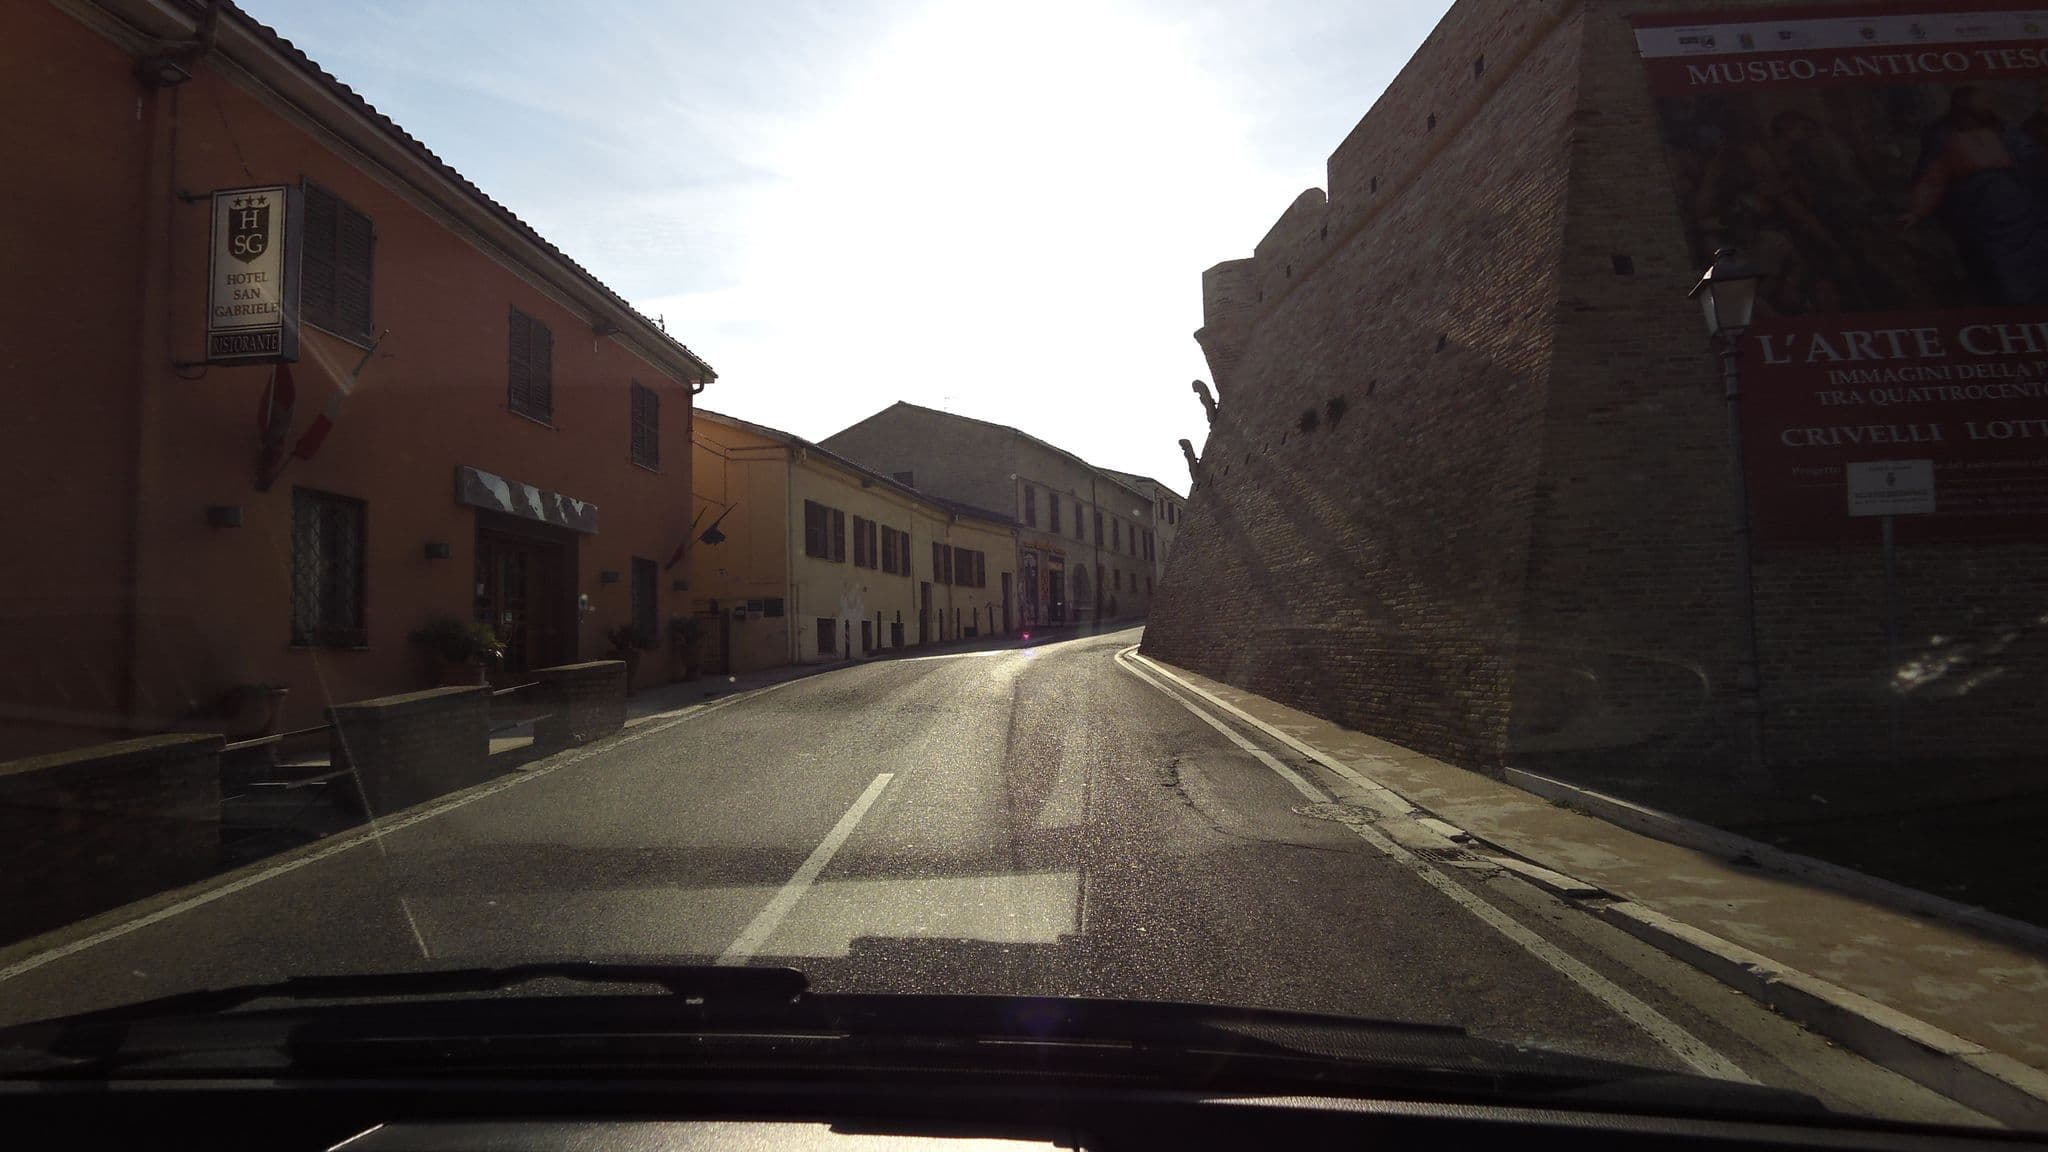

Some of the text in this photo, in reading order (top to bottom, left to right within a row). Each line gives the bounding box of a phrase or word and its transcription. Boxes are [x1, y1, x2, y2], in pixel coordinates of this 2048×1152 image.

[1687, 50, 1970, 86] MUSEO-ANTICO
[240, 209, 259, 230] H
[233, 233, 264, 256] SG
[226, 272, 268, 286] HOTEL
[233, 287, 261, 301] SAN
[214, 302, 280, 318] GABRIELE
[214, 334, 279, 354] RISTORANTE
[1754, 327, 1946, 365] L'ARTE
[1828, 366, 1952, 386] IMMAGINI
[1958, 363, 2033, 379] DELLA
[1815, 390, 1865, 407] TRA
[1780, 423, 1946, 448] CRIVELLI
